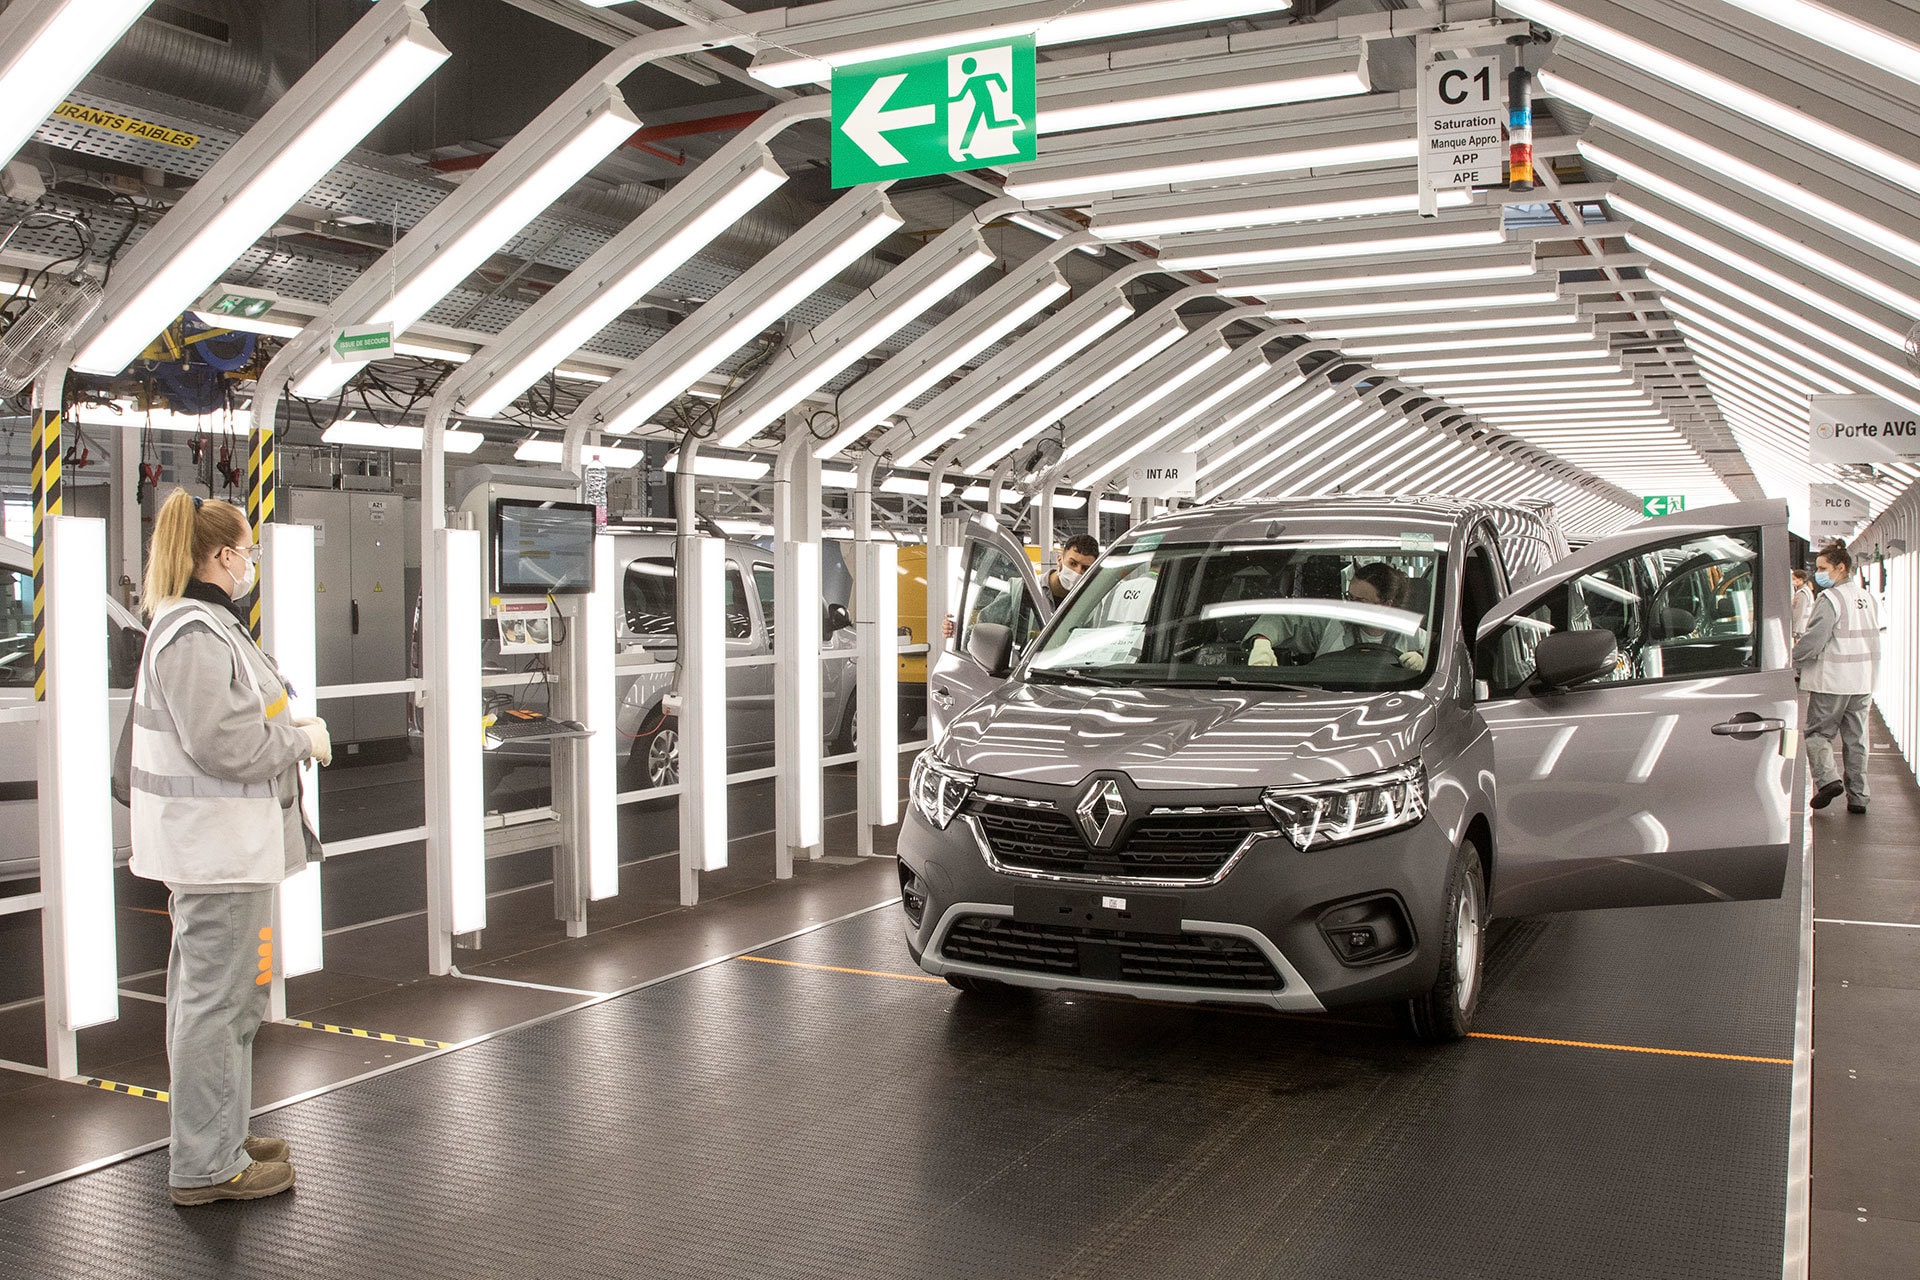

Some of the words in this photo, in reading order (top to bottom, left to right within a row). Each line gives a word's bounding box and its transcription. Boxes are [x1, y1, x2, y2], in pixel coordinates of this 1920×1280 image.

[1438, 66, 1490, 105] C1
[1434, 116, 1496, 131] Saturation
[125, 122, 194, 147] FAIBLES
[1431, 138, 1467, 149] Manque
[1468, 135, 1499, 147] Appro.
[1452, 153, 1479, 165] APP
[1453, 171, 1479, 183] APE
[364, 337, 389, 346] SECOURS
[1835, 422, 1878, 438] Porte
[1882, 420, 1917, 437] AVG
[1146, 468, 1163, 479] INT
[1164, 468, 1179, 479] AR
[1825, 498, 1842, 508] PLC
[1844, 498, 1851, 508] G
